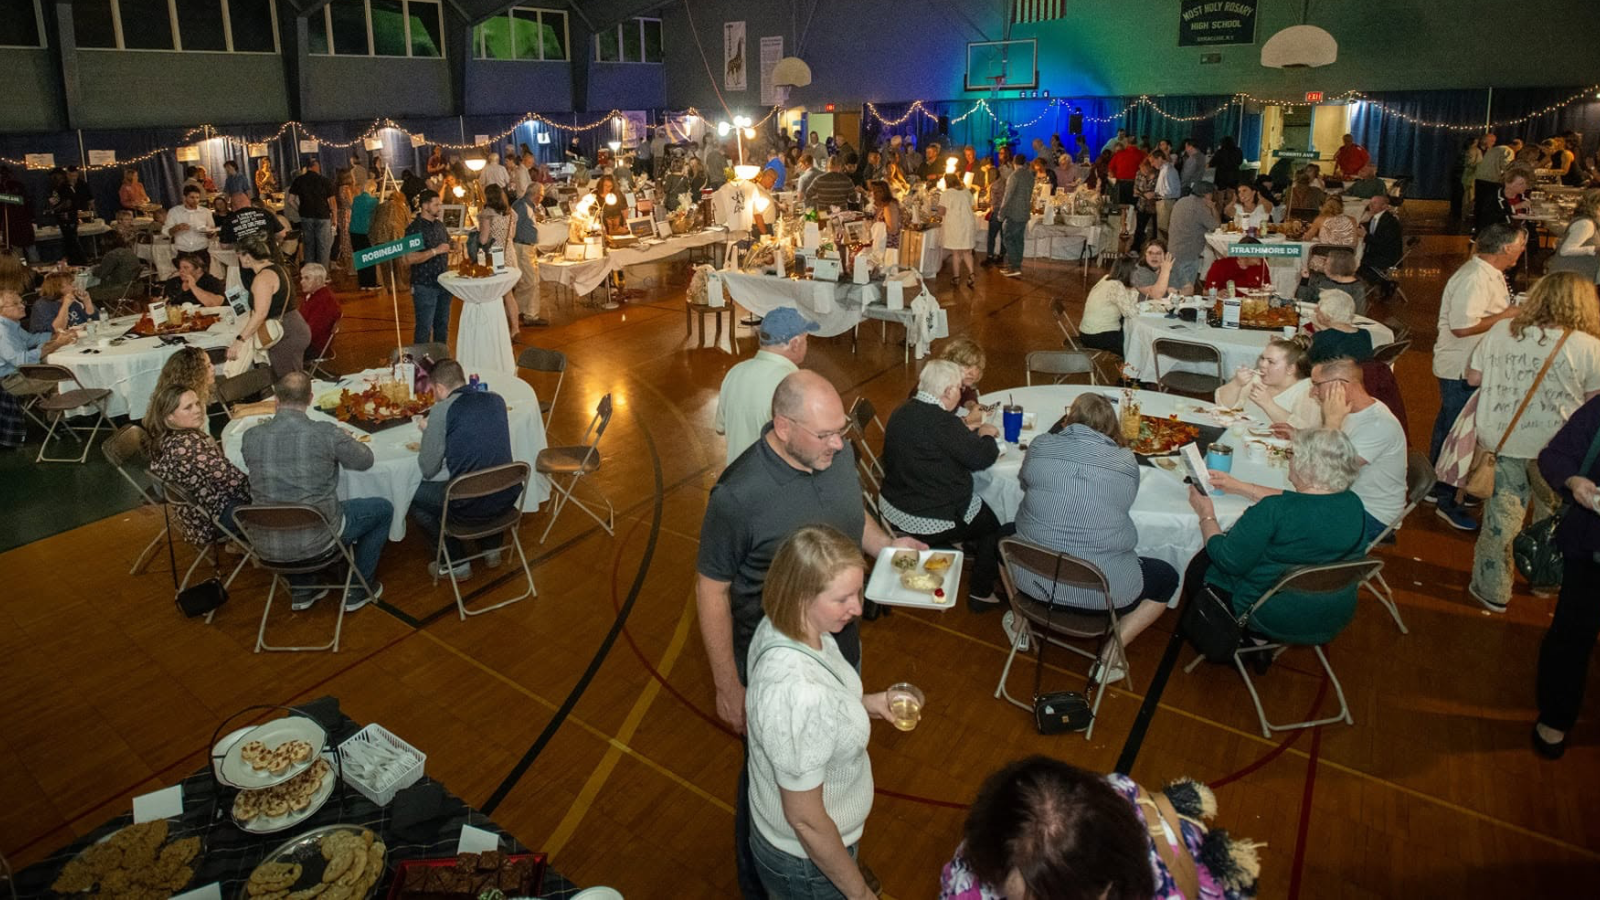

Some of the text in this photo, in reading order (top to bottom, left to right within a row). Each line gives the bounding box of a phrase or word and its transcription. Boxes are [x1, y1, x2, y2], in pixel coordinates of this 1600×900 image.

[1182, 1, 1254, 21] MOST HOLY ROSARY
[1191, 20, 1242, 31] HIGH SCHOOL
[361, 238, 421, 263] ROBINEAU RD
[1230, 246, 1299, 255] STRATHMORE DR
